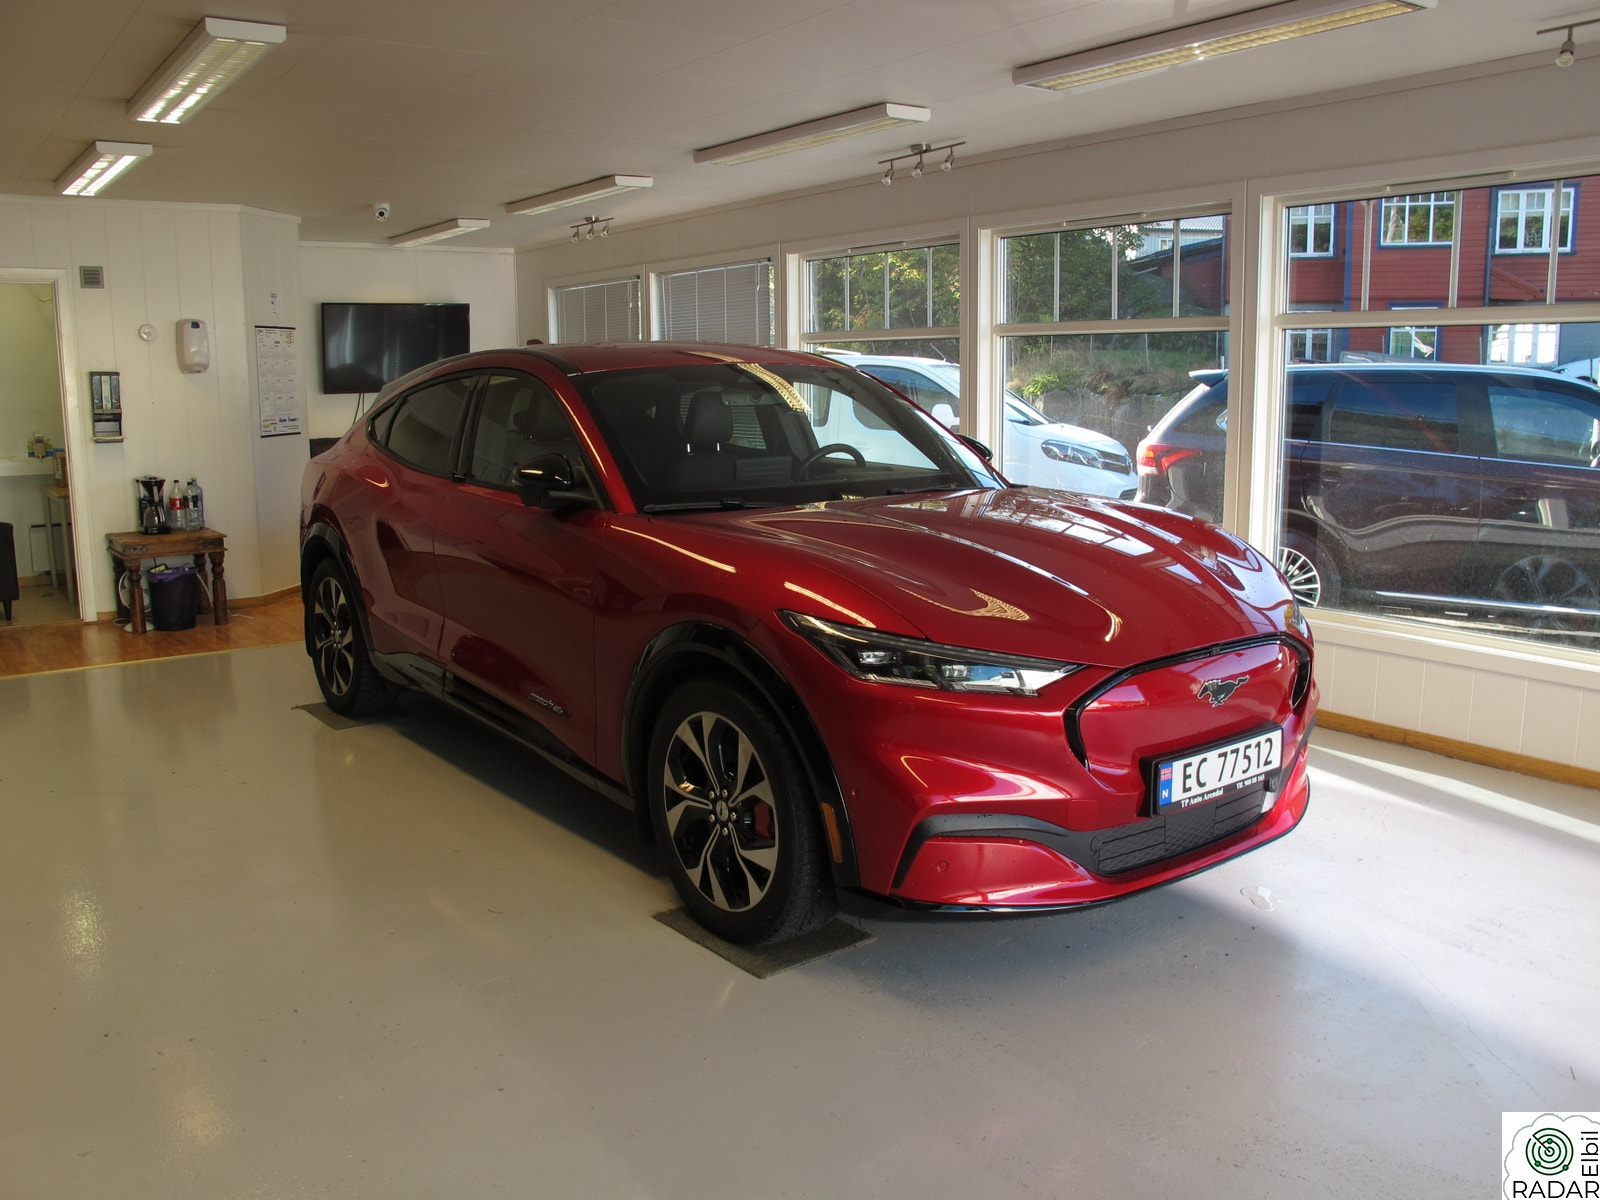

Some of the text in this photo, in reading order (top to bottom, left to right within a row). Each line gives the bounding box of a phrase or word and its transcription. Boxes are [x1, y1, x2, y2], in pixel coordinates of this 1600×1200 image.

[1182, 737, 1273, 794] EC 77512
[1161, 789, 1169, 799] N
[1181, 787, 1224, 808] TP Auto Arendal
